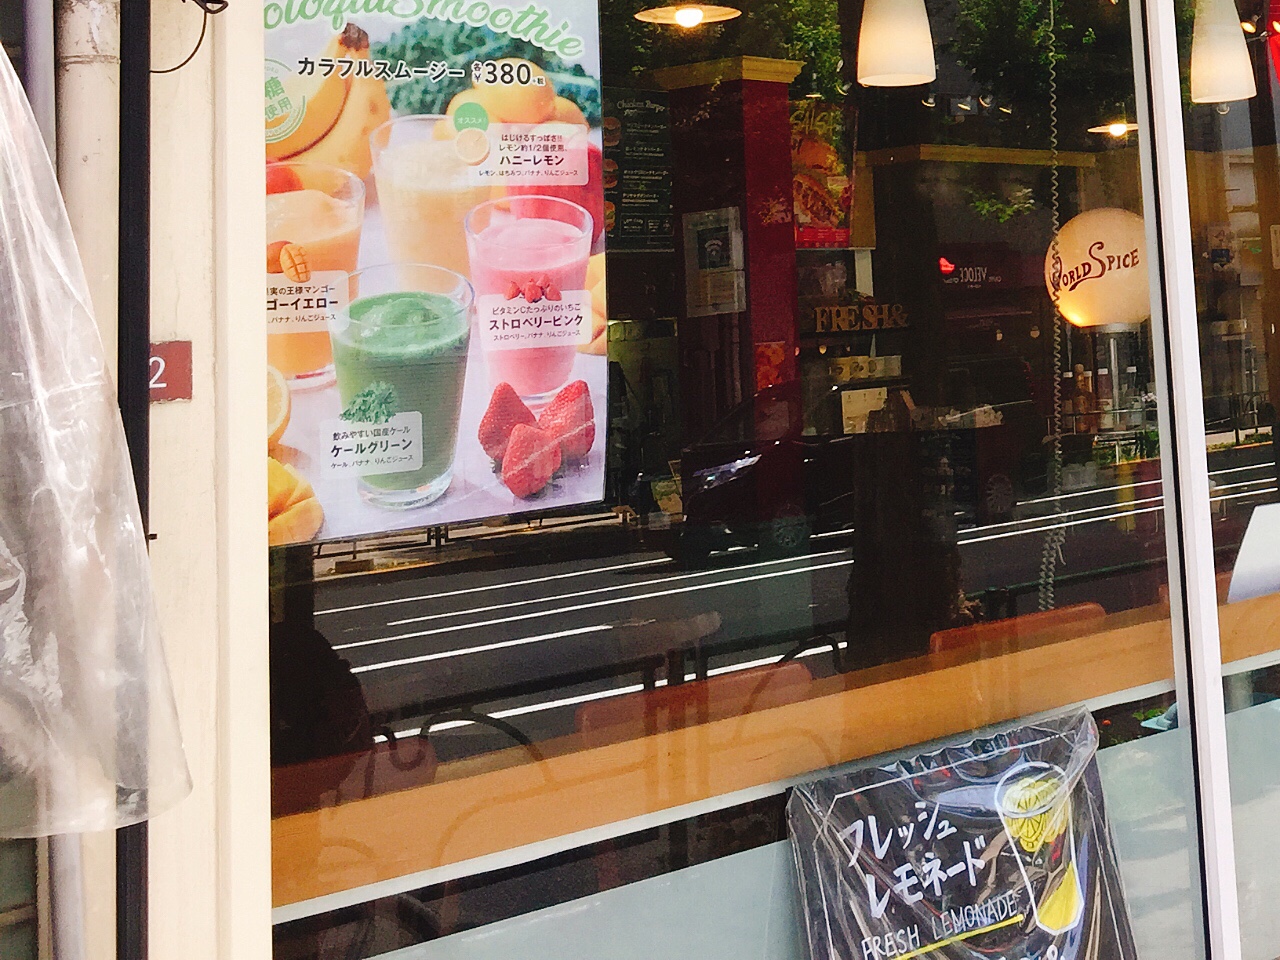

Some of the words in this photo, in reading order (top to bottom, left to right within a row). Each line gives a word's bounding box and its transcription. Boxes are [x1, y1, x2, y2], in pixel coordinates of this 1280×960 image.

[298, 57, 465, 82] カラフルスムージー
[499, 155, 564, 166] ハニーレモン
[1068, 241, 1140, 292] SPICE
[266, 285, 336, 296] 実の王様マンゴー
[489, 314, 583, 331] ストロベリーピンク
[332, 426, 411, 441] 飲みやすい国産ケール
[331, 438, 412, 458] ケールグリーン
[839, 801, 958, 868] フレッシュ
[865, 835, 986, 919] レモネード
[861, 924, 920, 960] FRESH
[931, 890, 1023, 941] LEMONADE
